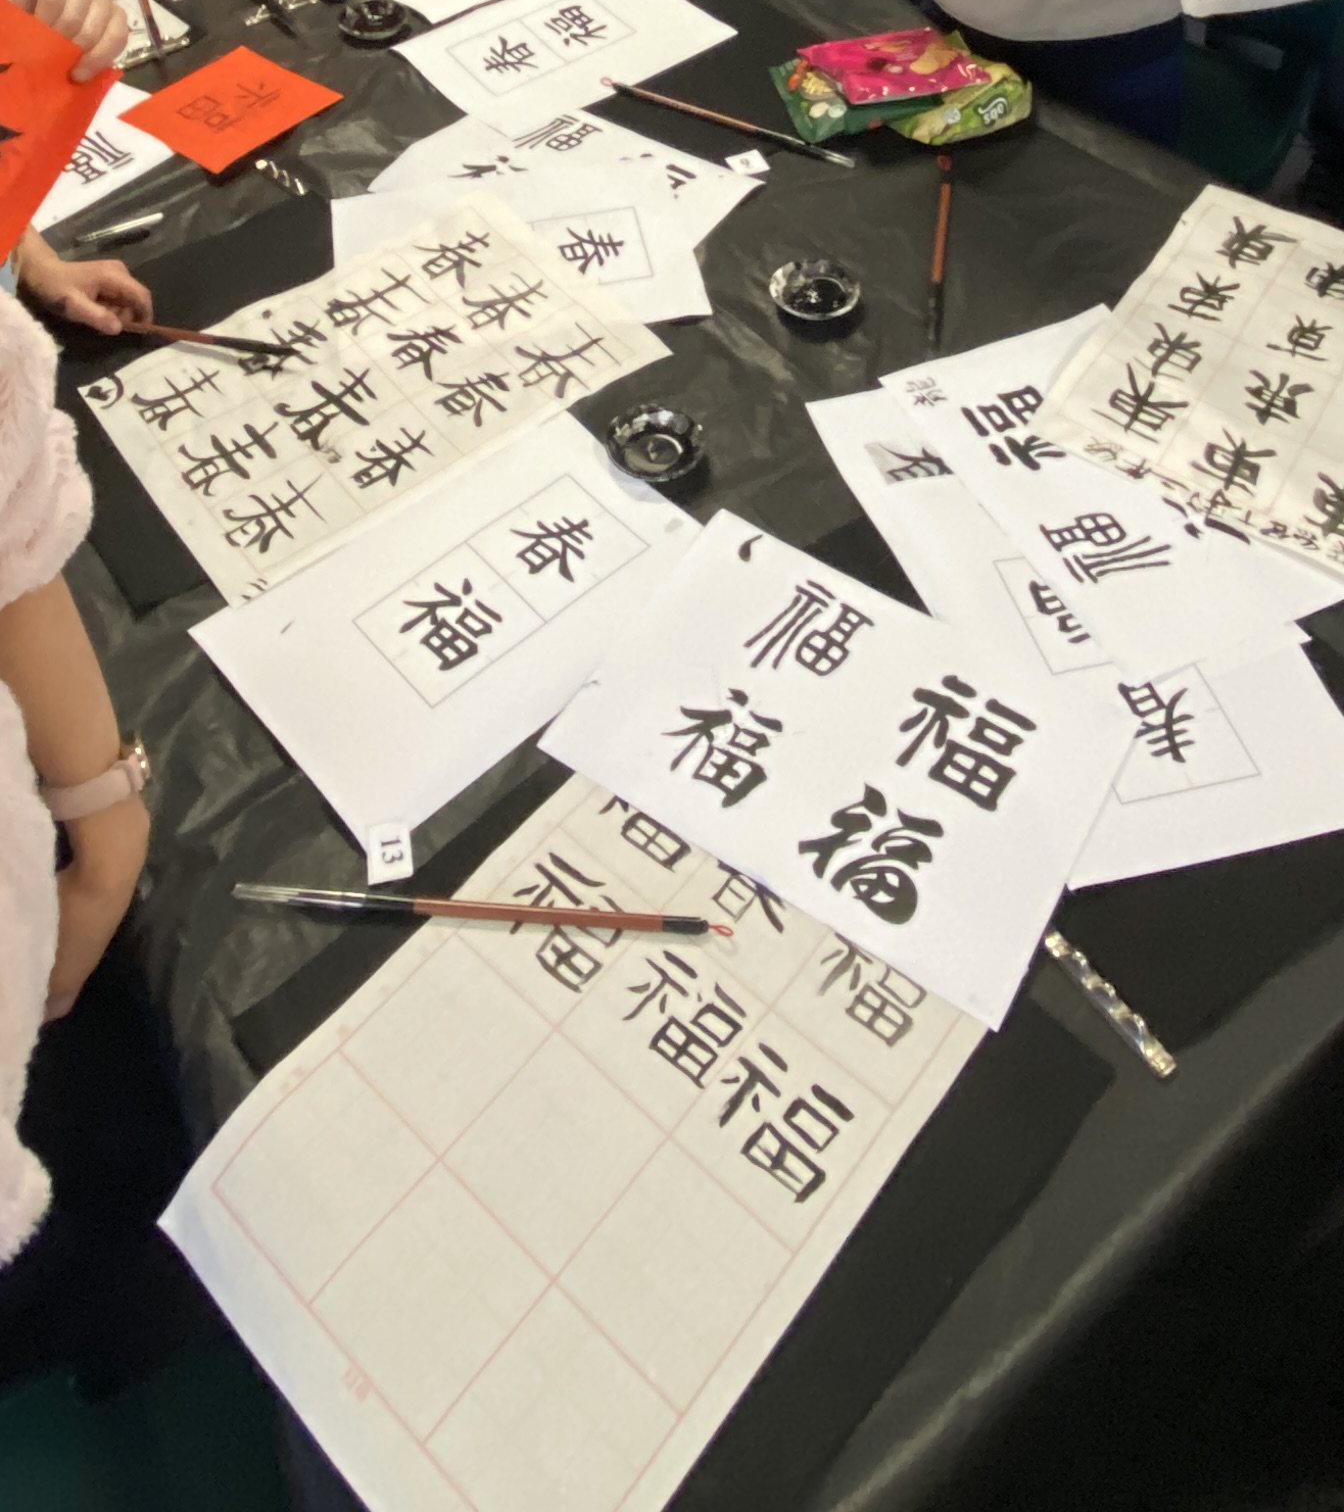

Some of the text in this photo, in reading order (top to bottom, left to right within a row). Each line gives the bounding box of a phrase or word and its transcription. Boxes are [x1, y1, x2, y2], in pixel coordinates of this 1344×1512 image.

[483, 34, 540, 79] 春
[552, 2, 609, 49] 福
[177, 81, 282, 134] 福
[413, 230, 493, 288] 春
[557, 226, 625, 276] 春
[462, 271, 552, 332] 春
[386, 323, 464, 382] 春
[435, 368, 512, 429] 春
[353, 426, 436, 491] 春
[509, 514, 595, 585] 春
[396, 577, 504, 672] 福
[743, 577, 875, 678] 福
[659, 689, 785, 809] 福
[897, 673, 1039, 814] 福
[379, 834, 405, 866] 13
[797, 781, 948, 927] 福
[622, 949, 748, 1090] 福
[718, 1041, 856, 1205] 福
